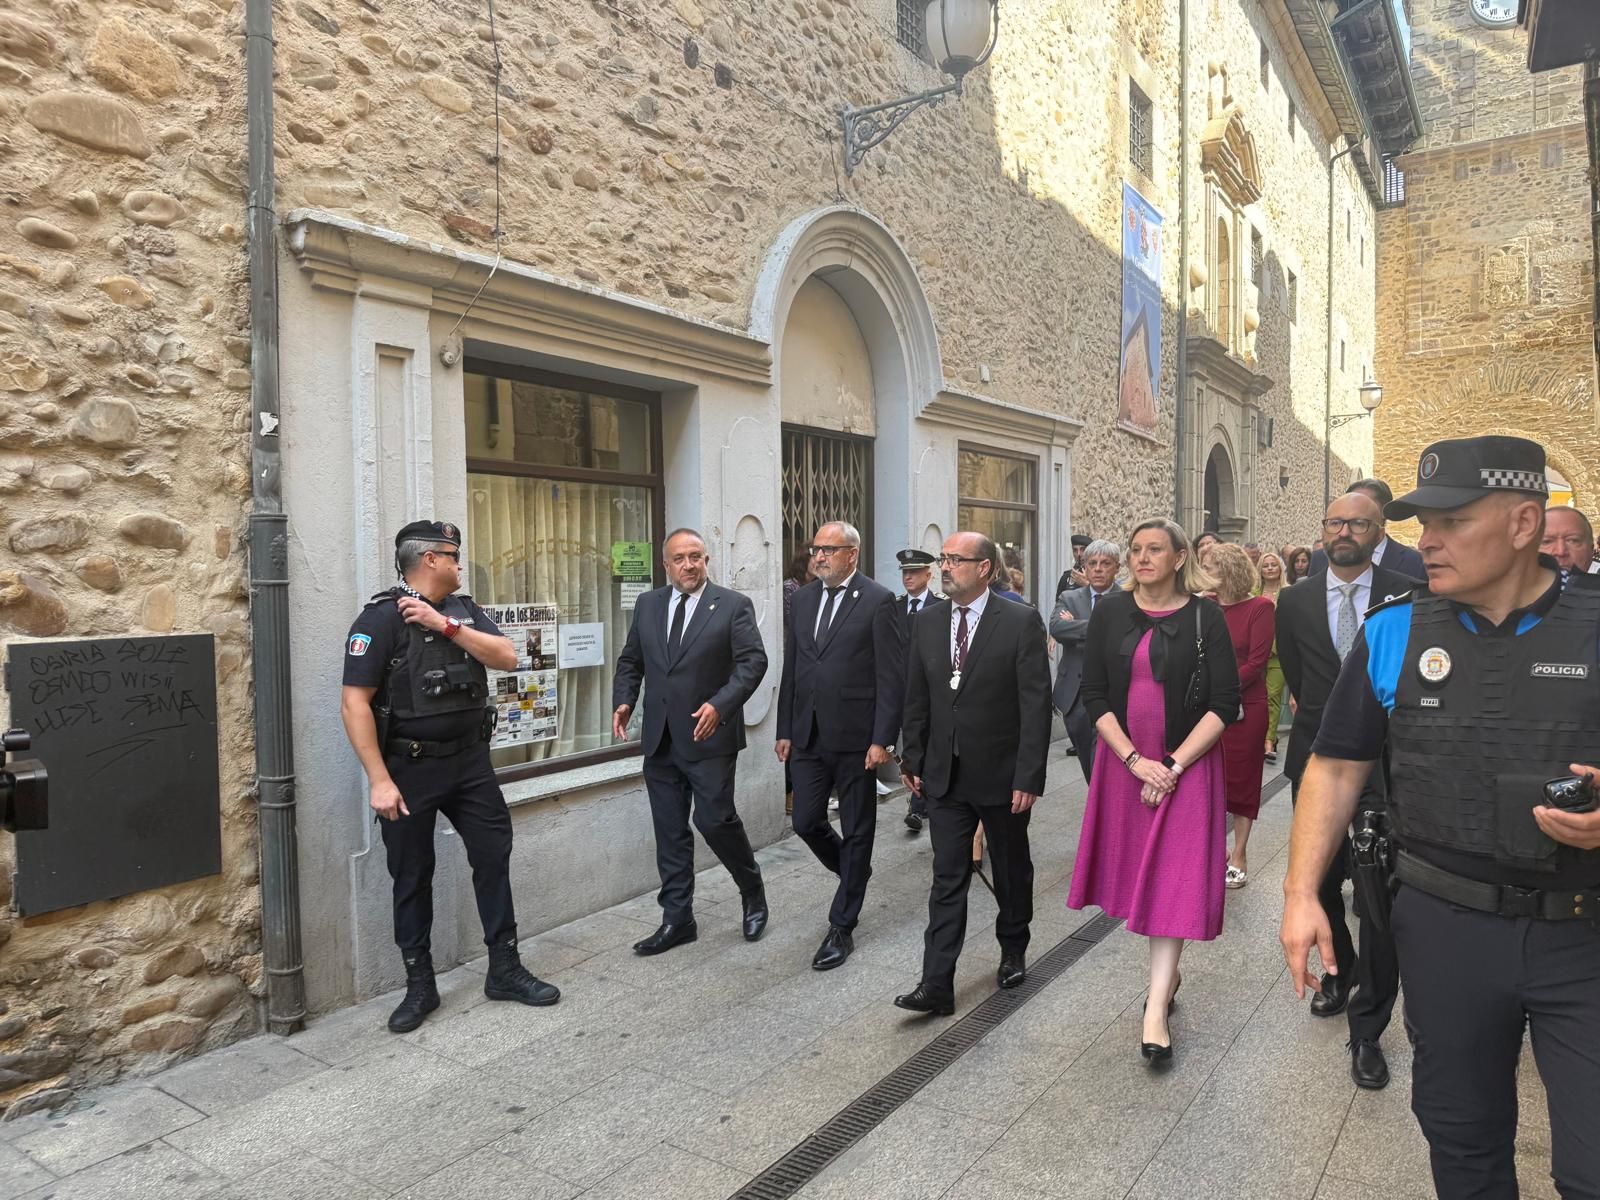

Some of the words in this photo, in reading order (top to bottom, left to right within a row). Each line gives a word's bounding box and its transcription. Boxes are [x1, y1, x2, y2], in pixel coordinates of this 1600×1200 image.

[505, 607, 515, 624] de
[517, 606, 528, 623] los
[530, 606, 556, 622] Barrios
[1534, 666, 1585, 676] POLICIA
